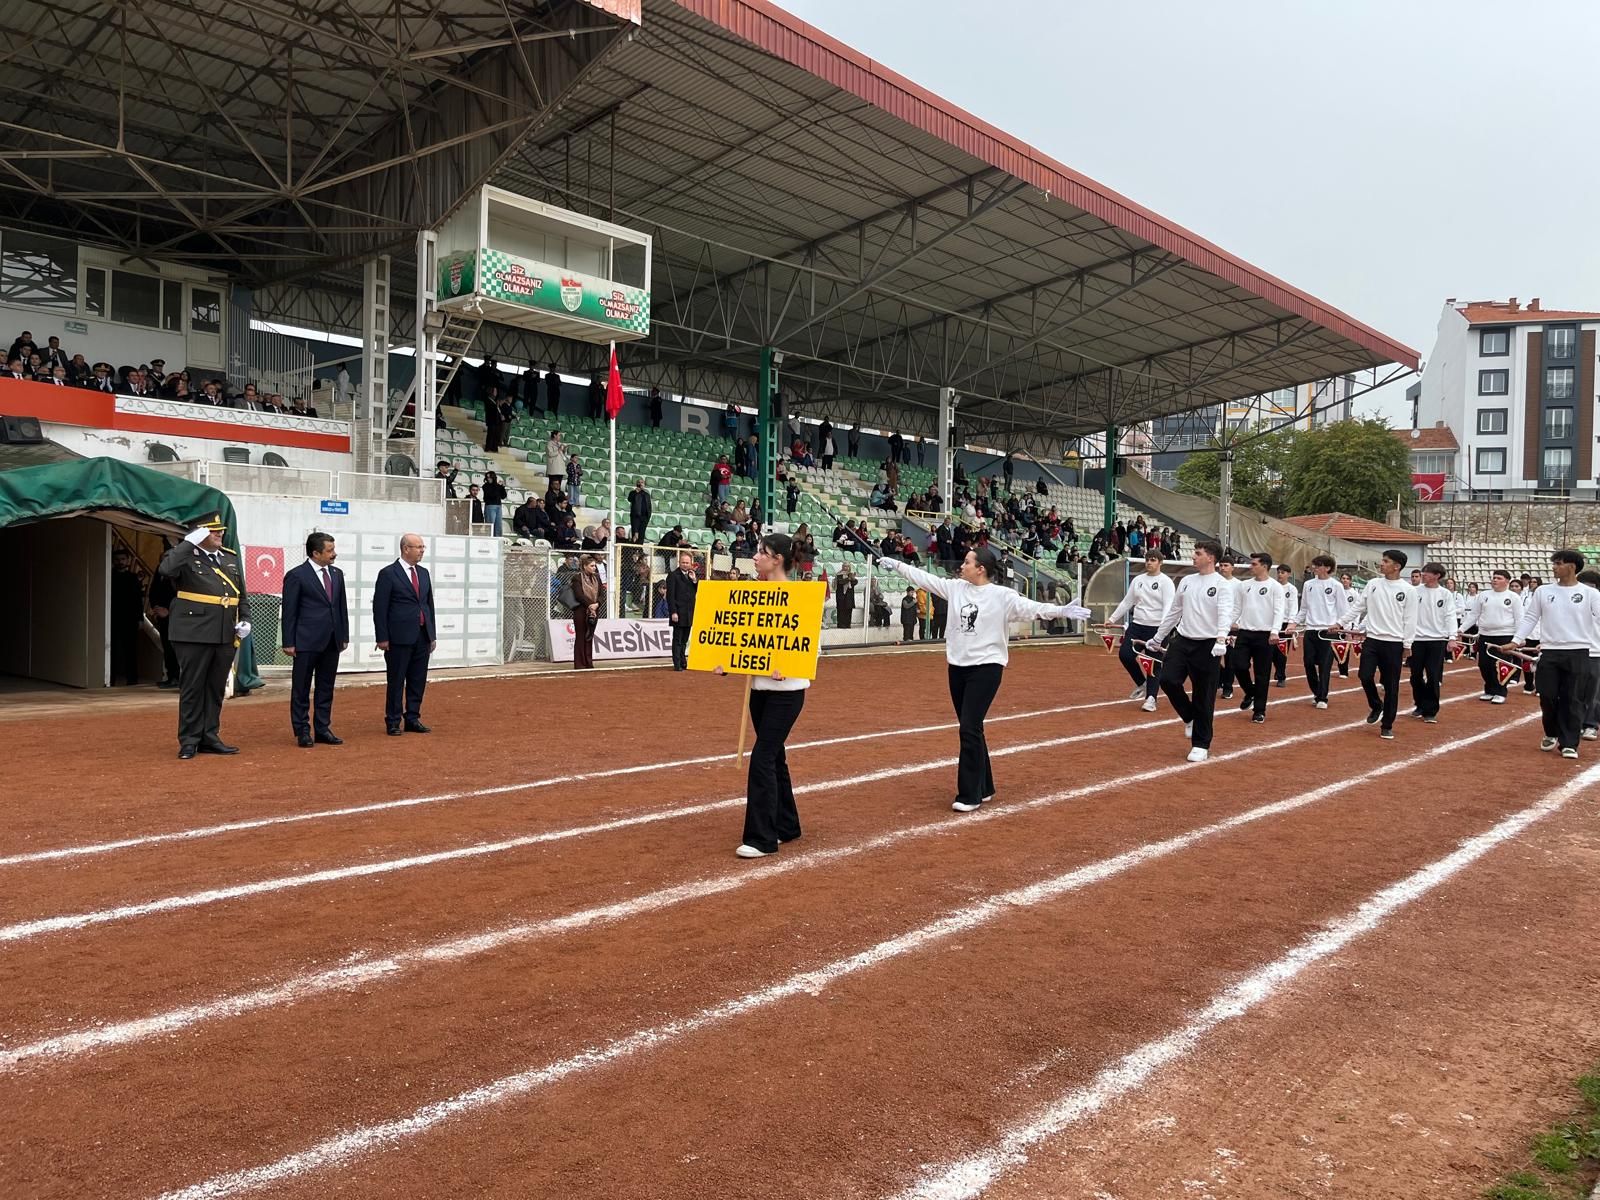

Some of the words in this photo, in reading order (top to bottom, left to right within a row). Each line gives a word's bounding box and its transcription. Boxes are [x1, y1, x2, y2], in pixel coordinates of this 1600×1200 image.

[495, 272, 543, 289] OLMAZSANIZ
[599, 299, 640, 314] OLMAZSANIZ
[728, 586, 789, 608] KIRŞEHİR
[713, 610, 755, 628] NEŞET
[757, 612, 800, 632] ERTAŞ
[698, 626, 738, 647] GÜZEL
[740, 632, 811, 652] SANATLAR
[730, 649, 772, 672] LİSESİ
